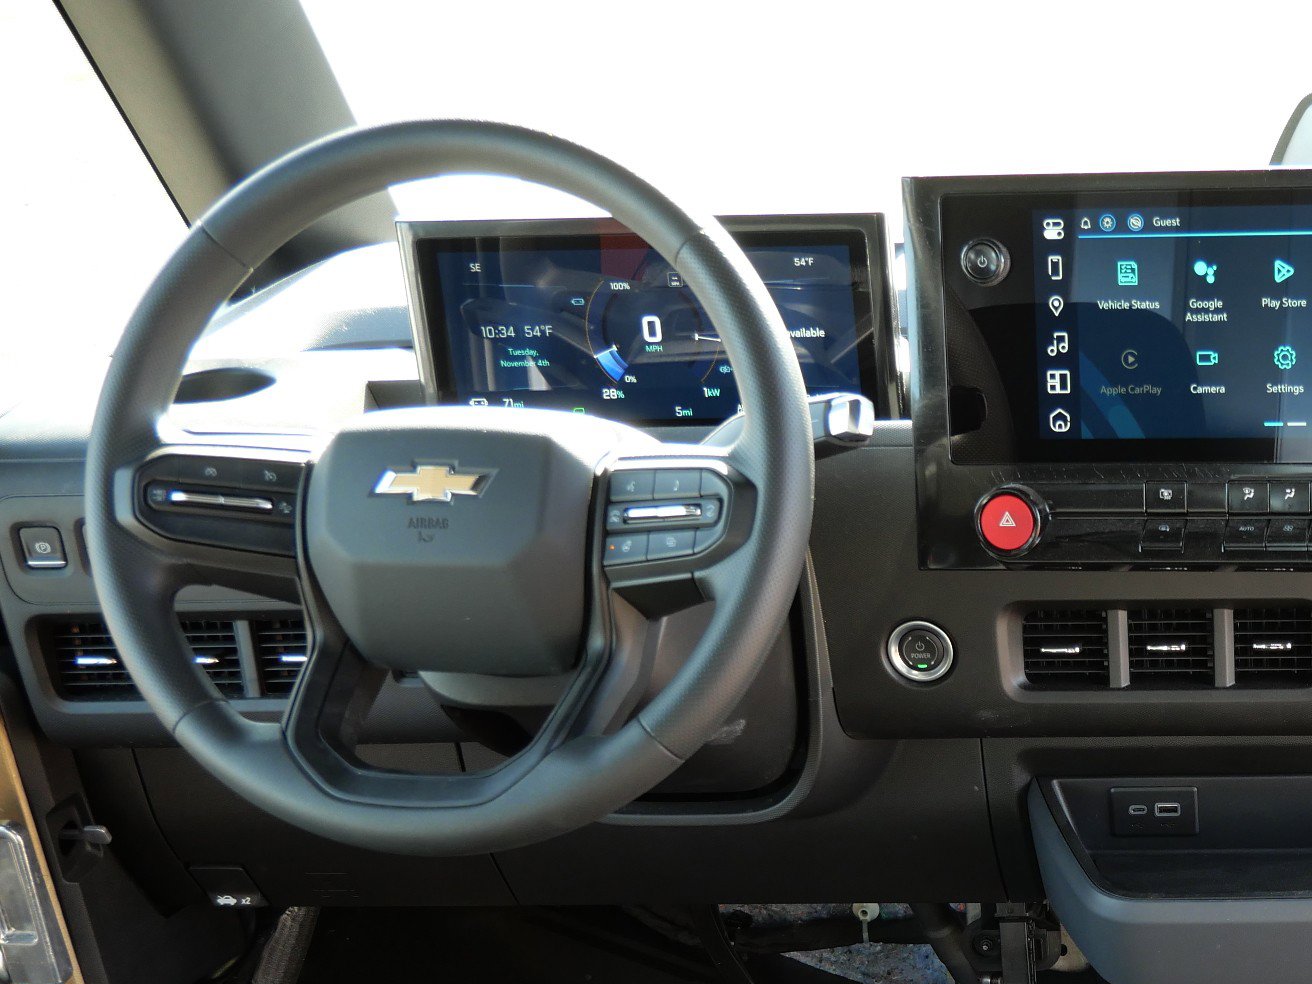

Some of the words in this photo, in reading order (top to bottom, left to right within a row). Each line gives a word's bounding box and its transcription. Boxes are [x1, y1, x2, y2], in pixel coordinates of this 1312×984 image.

[1153, 217, 1180, 227] Guest
[470, 263, 481, 272] SE
[794, 258, 814, 267] 54°F
[609, 282, 630, 290] 100%
[1098, 299, 1130, 309] Vehicle
[1131, 299, 1160, 309] Status
[1189, 298, 1223, 311] Google
[1262, 298, 1281, 309] Play
[1282, 297, 1307, 307] Store
[1185, 313, 1228, 322] Assistant
[481, 326, 515, 338] 10:34
[524, 325, 553, 337] 54°F
[641, 315, 663, 343] 0
[788, 327, 826, 338] vailable
[624, 375, 637, 383] 0%
[602, 388, 625, 399] 28%
[1100, 385, 1127, 396] Apple
[1128, 384, 1162, 396] CarPlay
[1190, 384, 1226, 394] Camera
[1266, 383, 1304, 395] Settings
[408, 517, 449, 529] AIRBAG
[241, 897, 251, 905] x2
